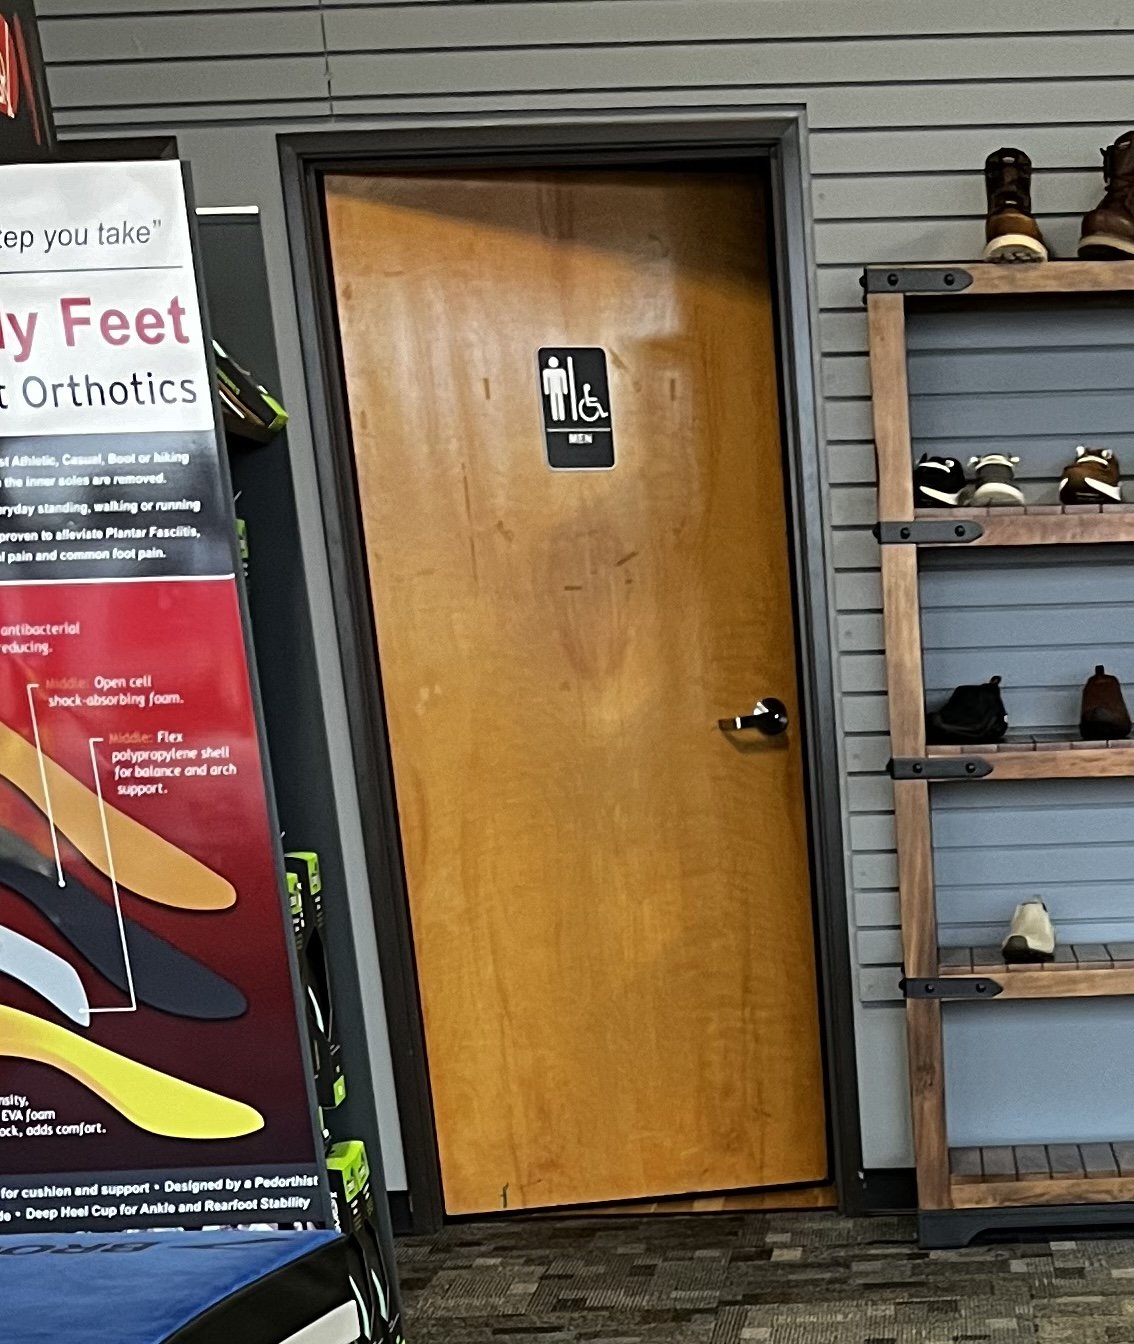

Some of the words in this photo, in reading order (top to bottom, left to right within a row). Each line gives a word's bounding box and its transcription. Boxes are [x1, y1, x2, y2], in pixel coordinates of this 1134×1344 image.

[44, 228, 88, 253] you
[0, 310, 38, 362] y
[60, 296, 190, 347] Feet
[22, 372, 197, 408] Orthotics
[11, 455, 59, 467] Athletic,
[62, 453, 105, 466] Casual,
[108, 452, 136, 464] Boot
[138, 454, 151, 464] or
[153, 451, 190, 465] hiking
[4, 476, 23, 488] the
[25, 475, 56, 487] inner
[58, 475, 90, 486] soles
[92, 476, 111, 486] are
[113, 472, 167, 485] removed.
[93, 500, 138, 514] walking
[140, 501, 154, 512] or
[155, 498, 201, 513] running
[41, 529, 54, 541] to
[55, 527, 103, 541] alleviate
[105, 527, 147, 539] Plantar
[149, 525, 201, 539] Fasciitis,
[8, 549, 33, 564] pain
[35, 549, 58, 561] and
[60, 550, 110, 561] common
[112, 547, 136, 560] foot
[137, 546, 167, 561] pain.
[0, 621, 80, 636] antibacterial
[94, 675, 126, 692] Open
[129, 674, 152, 688] cell
[48, 690, 146, 708] shock-absorbing
[148, 690, 184, 707] foam.
[157, 730, 184, 743] Flex
[111, 747, 198, 764] polypropylene
[201, 745, 230, 759] shell
[114, 764, 133, 781] for
[134, 763, 182, 777] balance
[184, 763, 208, 776] and
[210, 762, 237, 776] arch
[117, 783, 168, 797] support.
[1, 1109, 24, 1122] EVA
[25, 1108, 56, 1123] foam
[25, 1123, 54, 1136] adds
[55, 1121, 107, 1136] comfort.
[0, 1187, 19, 1199] for
[21, 1185, 72, 1199] cushion
[74, 1183, 99, 1196] and
[101, 1182, 150, 1197] support
[164, 1178, 223, 1194] Designed
[225, 1178, 241, 1192] by
[243, 1178, 252, 1189] a
[254, 1174, 319, 1188] Pedorthist
[26, 1207, 59, 1221] Deep
[60, 1205, 89, 1218] Heel
[91, 1204, 117, 1219] Cup
[119, 1203, 138, 1215] for
[140, 1202, 176, 1215] Ankle
[178, 1201, 201, 1213] and
[204, 1198, 258, 1212] Rearfoot
[260, 1196, 311, 1211] Stability
